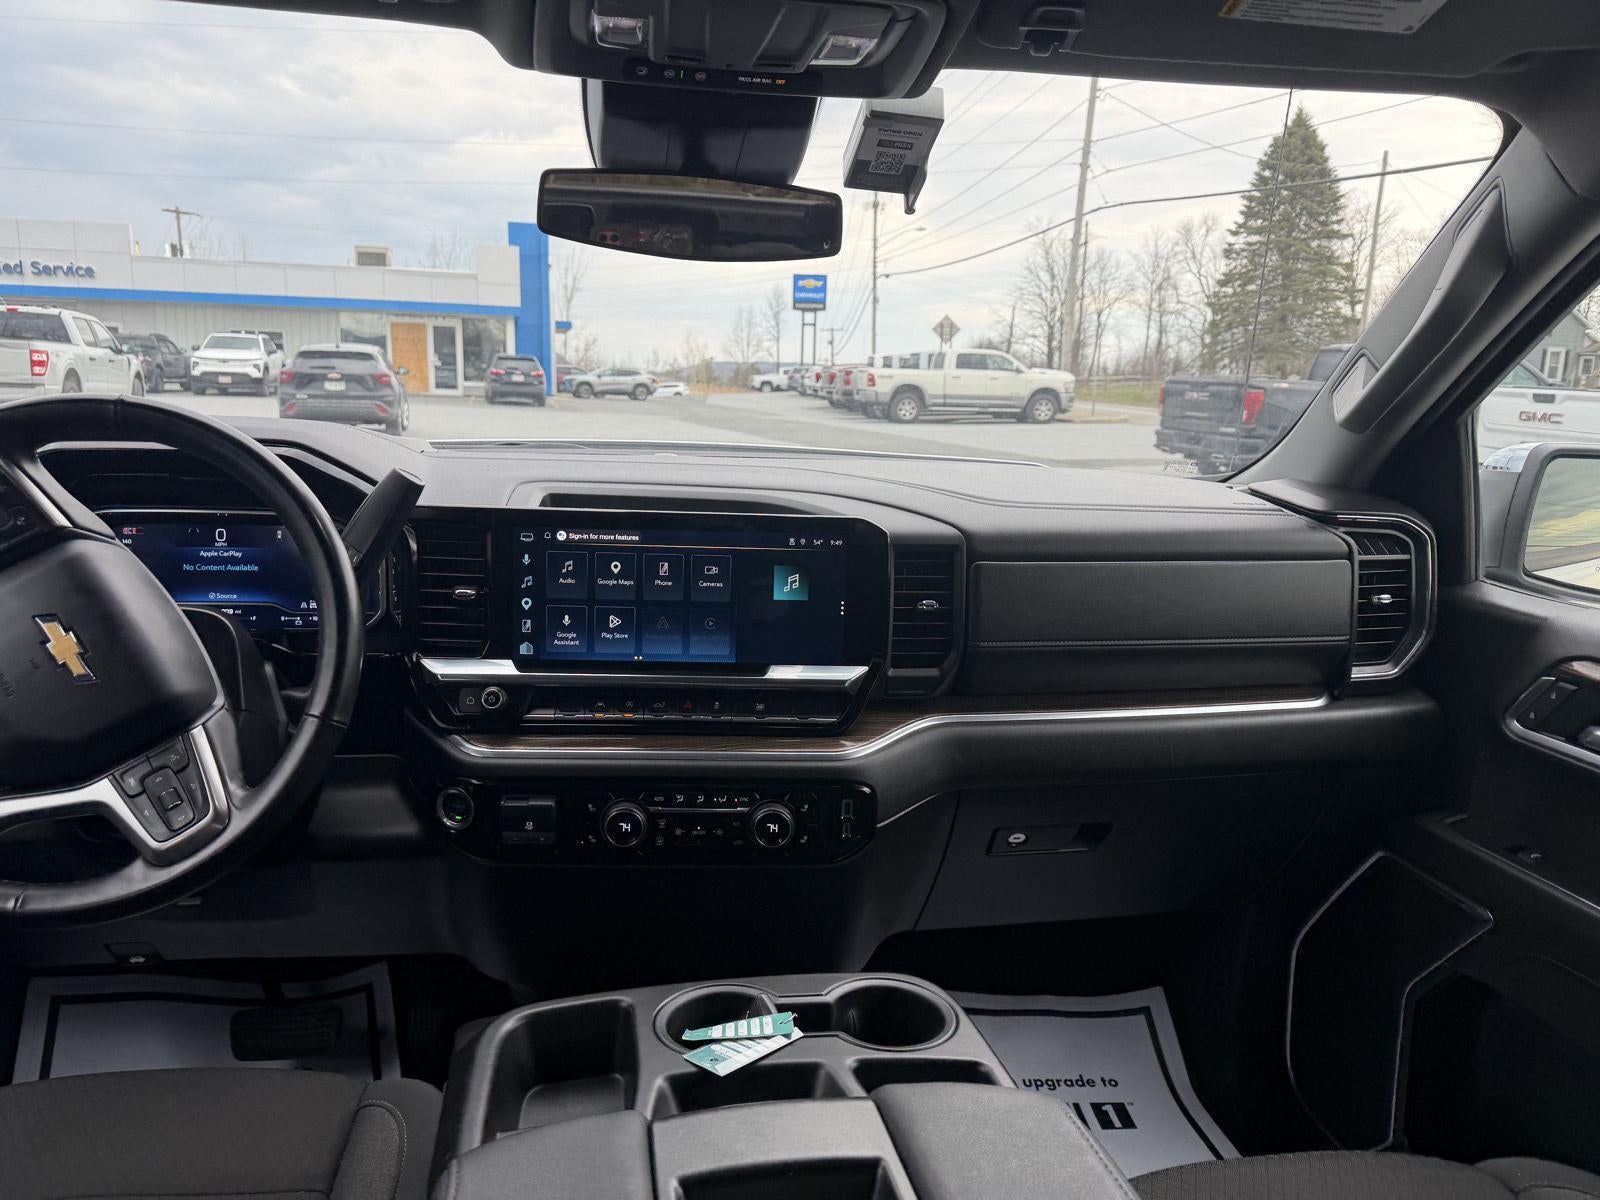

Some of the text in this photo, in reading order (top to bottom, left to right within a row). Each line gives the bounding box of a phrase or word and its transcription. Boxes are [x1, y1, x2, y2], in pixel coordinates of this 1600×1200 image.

[30, 260, 96, 279] Service
[1518, 410, 1565, 425] GMC
[568, 532, 589, 541] Sign-in
[615, 533, 640, 541] features
[199, 550, 242, 559] Apple CarPlay
[182, 563, 259, 572] No Content Available
[601, 632, 613, 640] Play
[618, 822, 631, 833] 74
[766, 823, 779, 833] 74
[1021, 1074, 1119, 1091] upgrade to
